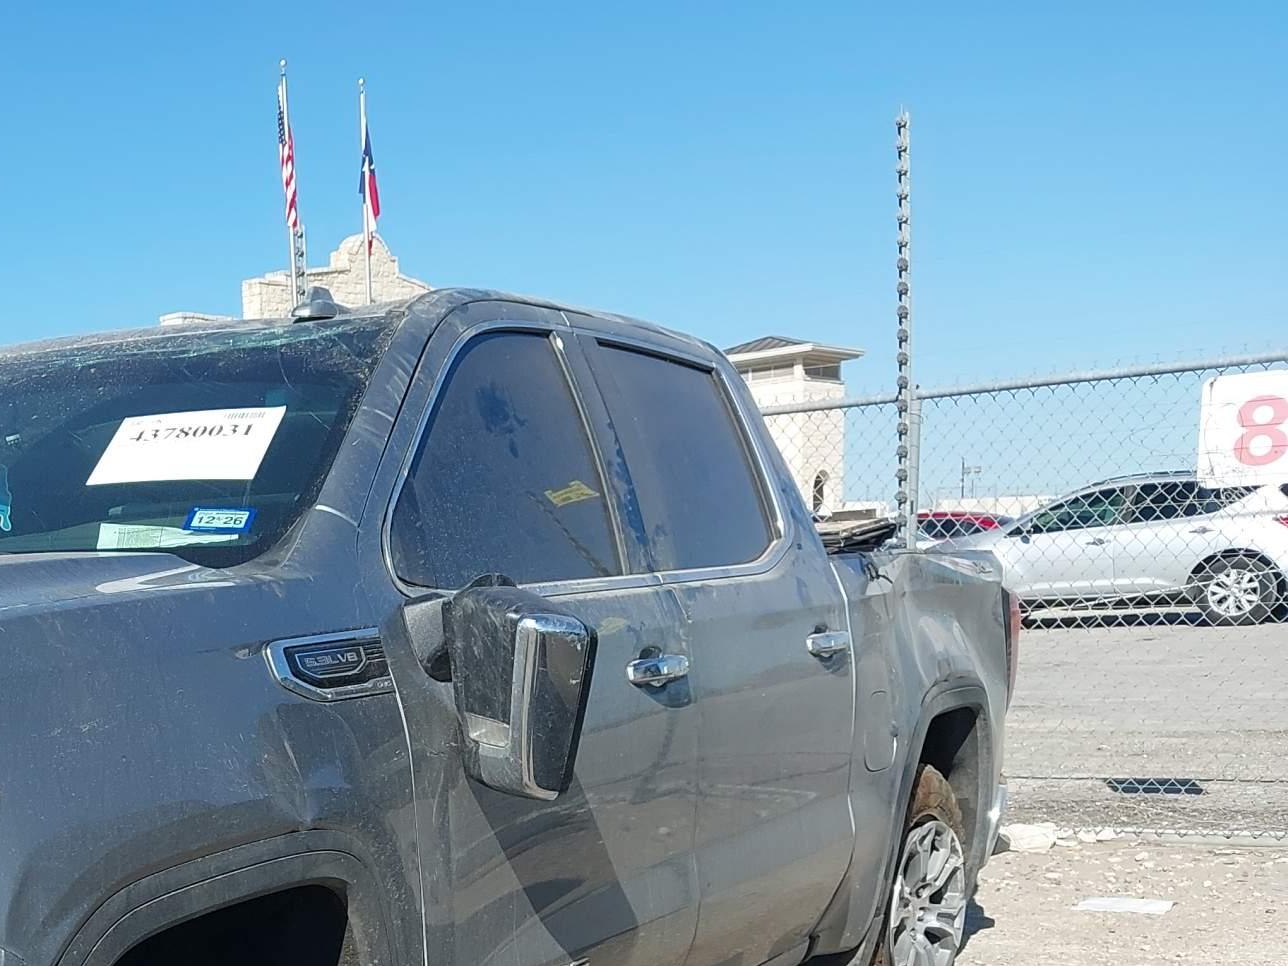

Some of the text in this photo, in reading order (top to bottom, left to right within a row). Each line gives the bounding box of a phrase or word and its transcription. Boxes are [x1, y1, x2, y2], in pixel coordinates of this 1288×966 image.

[128, 422, 255, 442] 43780031
[1233, 394, 1288, 467] 8
[198, 515, 244, 525] 12 26
